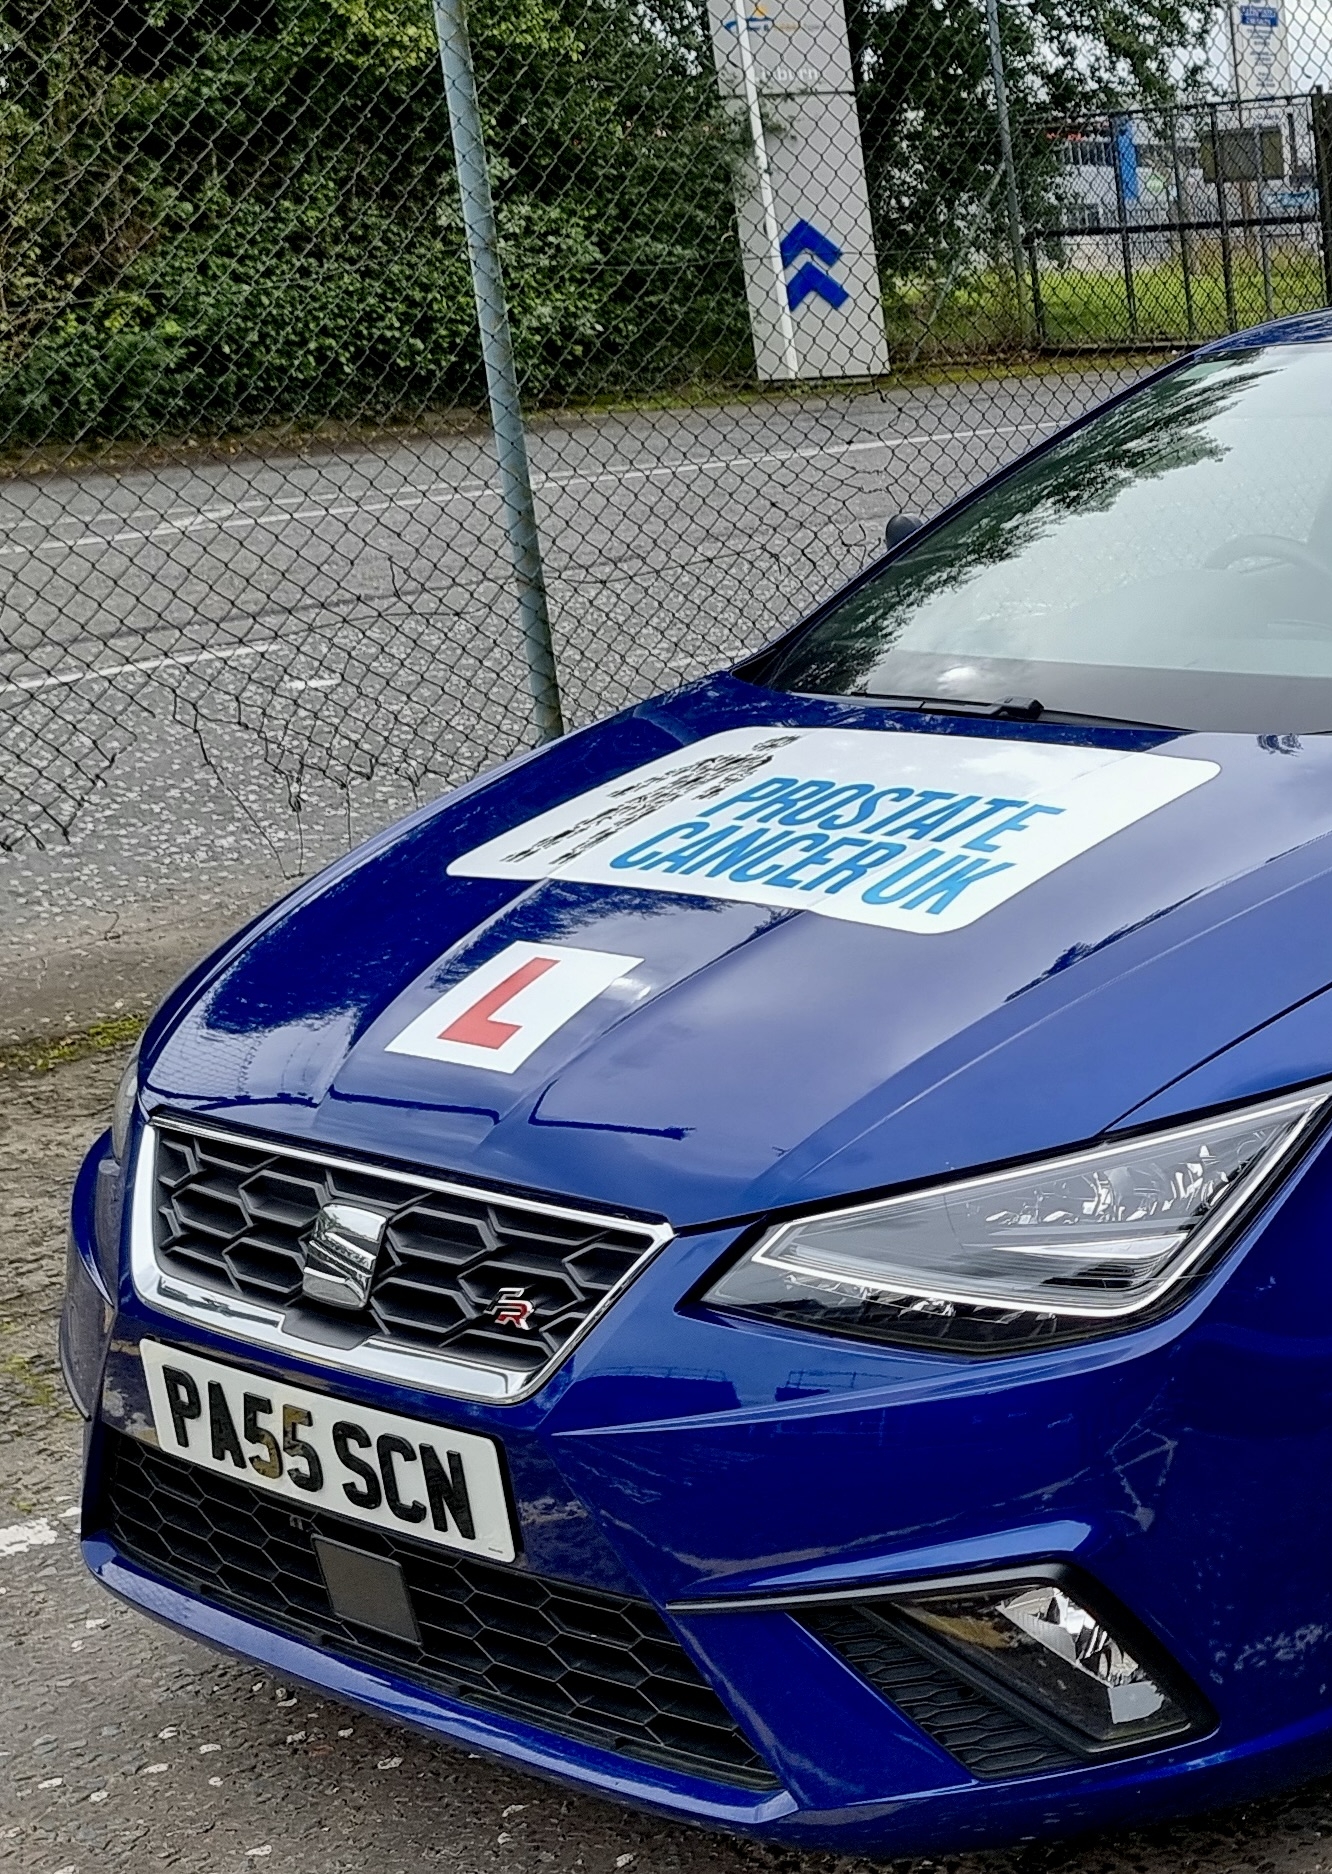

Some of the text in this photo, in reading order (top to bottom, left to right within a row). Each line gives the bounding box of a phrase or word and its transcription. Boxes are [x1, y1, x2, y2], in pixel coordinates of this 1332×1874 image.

[696, 777, 1067, 853] PROSTATE
[609, 821, 1017, 915] CANCER UK
[436, 956, 561, 1050] L
[162, 1364, 477, 1541] PA55 SCN
